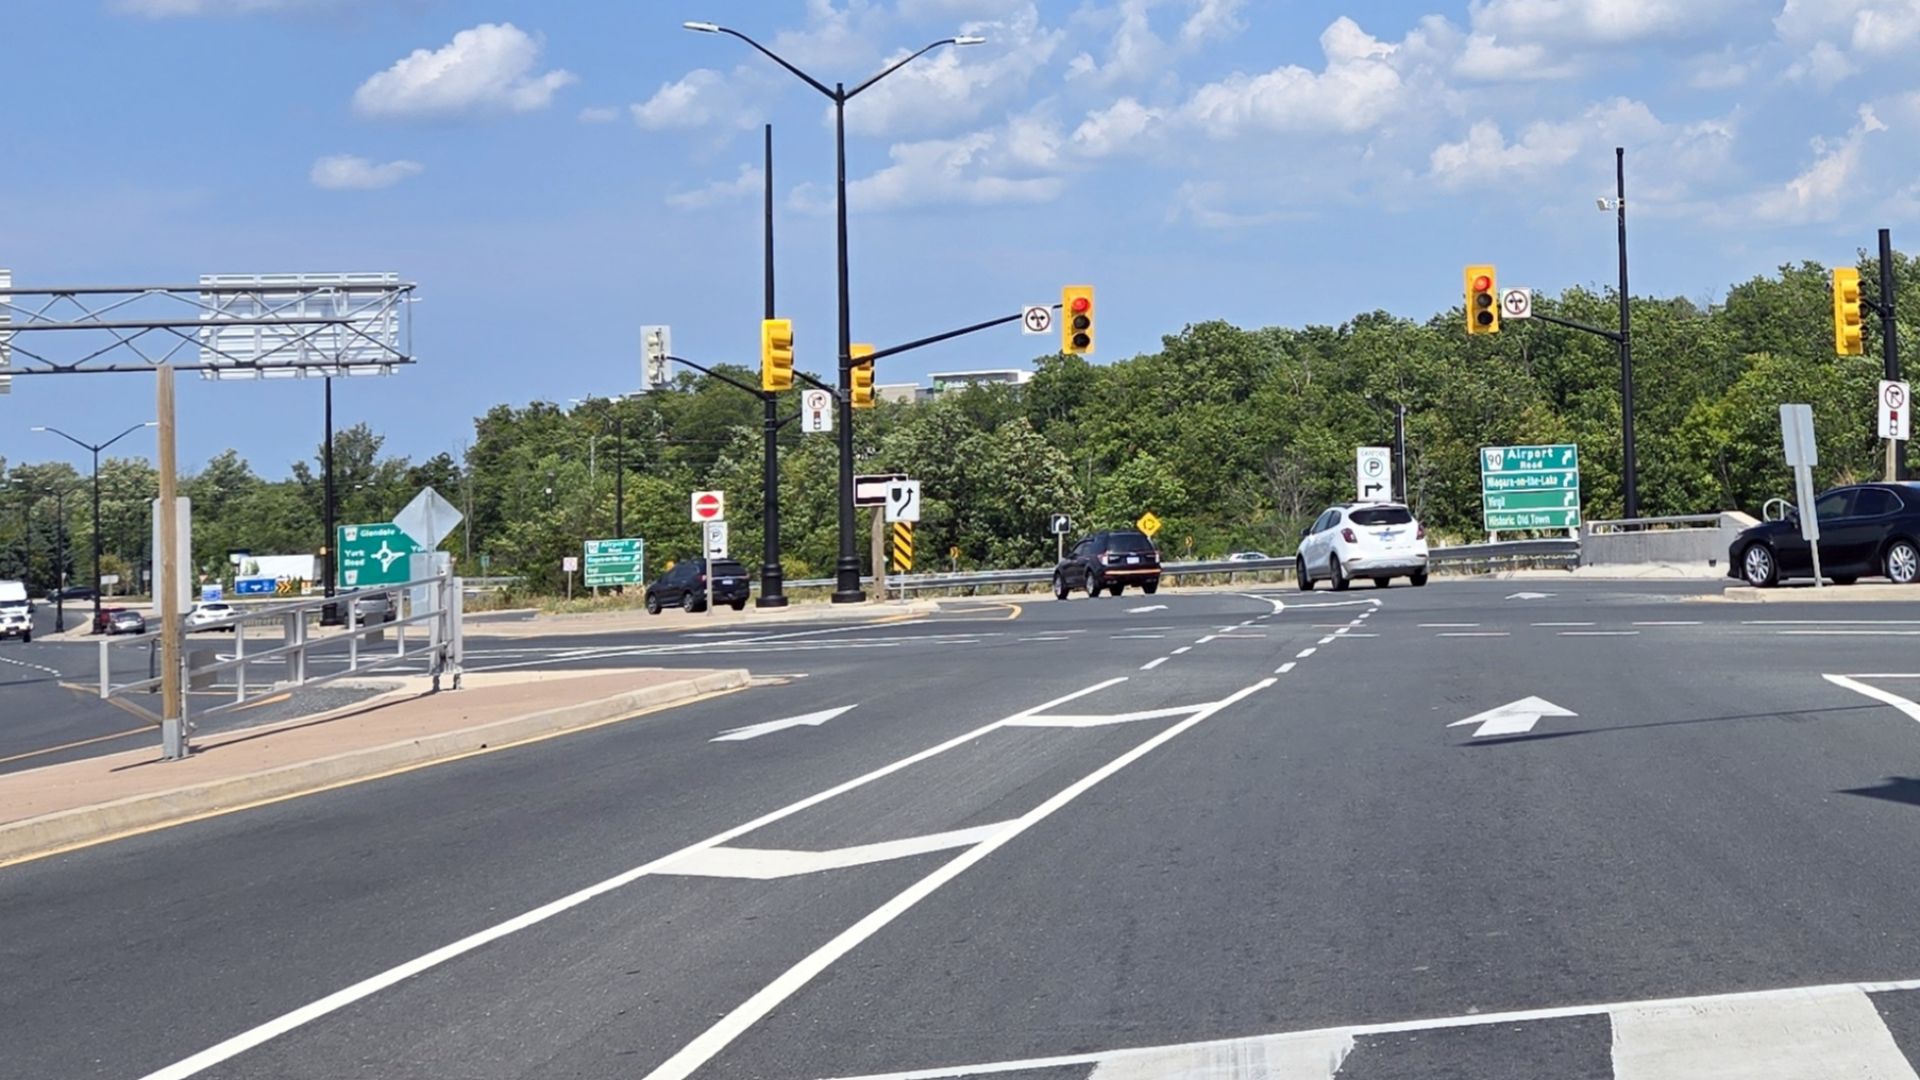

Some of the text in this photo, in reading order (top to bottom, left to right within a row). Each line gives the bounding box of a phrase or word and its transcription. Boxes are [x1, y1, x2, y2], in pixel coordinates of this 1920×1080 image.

[1488, 448, 1553, 466] 90 Airport
[1516, 514, 1529, 526] Old
[1531, 514, 1550, 525] Town
[360, 529, 396, 537] Glendale
